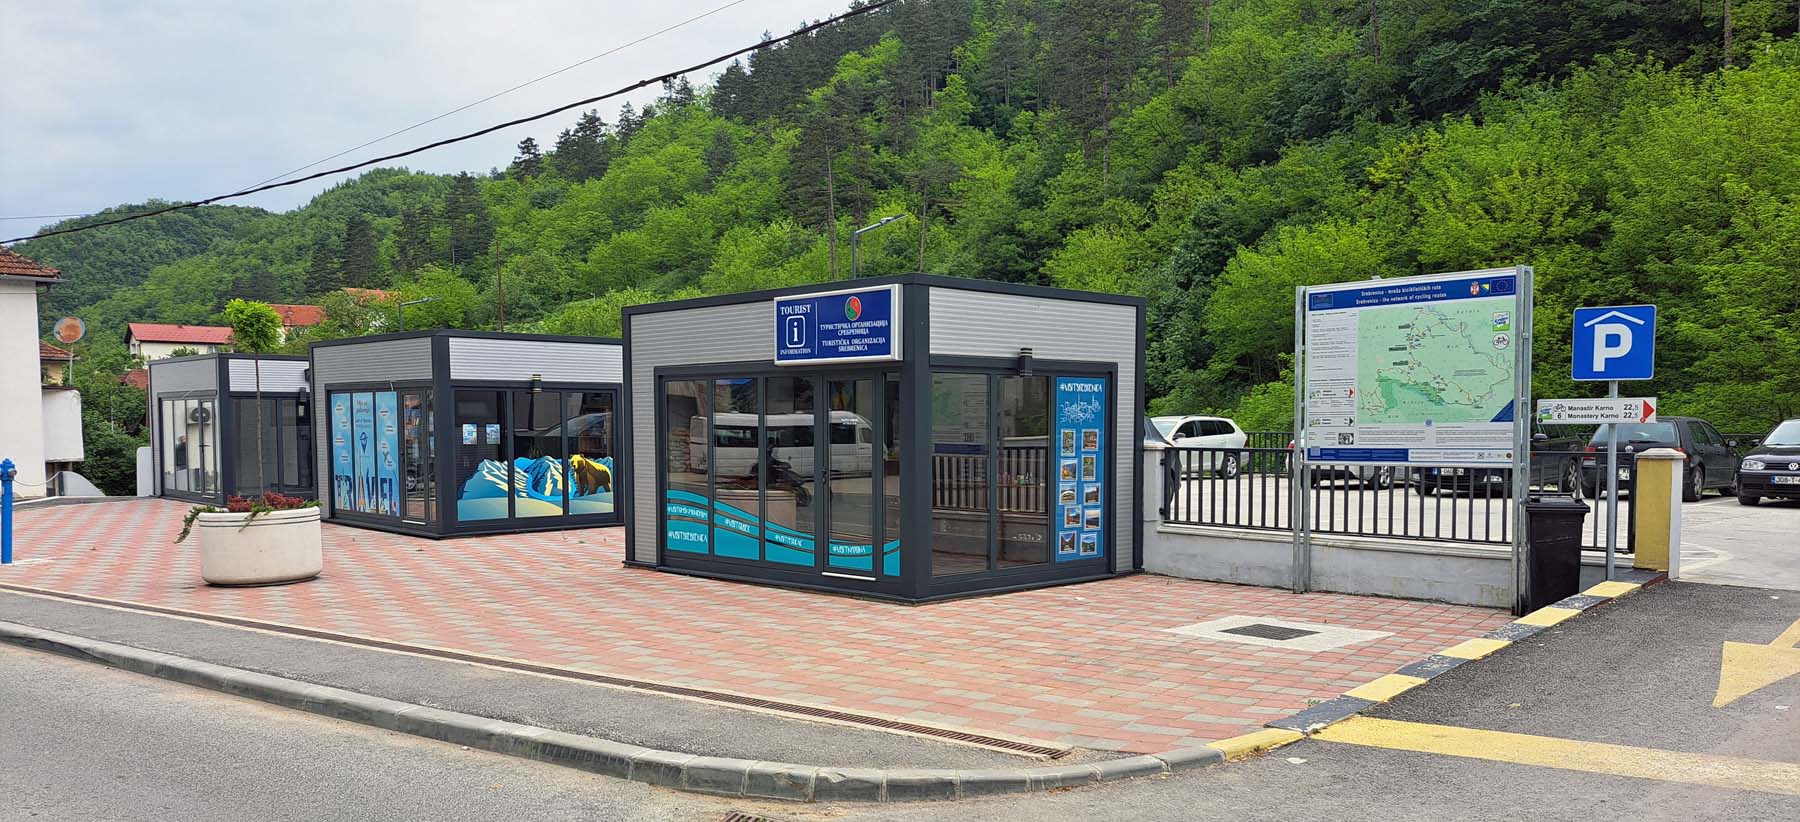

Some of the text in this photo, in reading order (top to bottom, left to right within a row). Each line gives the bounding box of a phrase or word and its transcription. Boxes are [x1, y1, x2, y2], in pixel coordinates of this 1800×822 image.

[1415, 293, 1431, 301] cycling
[780, 304, 811, 315] TOURIST
[820, 323, 851, 331] ТУРИСТИЧКА
[822, 336, 886, 347] TURISTIČKA ORGANIZACIJA
[838, 344, 868, 352] SREBRENICA
[1592, 323, 1633, 372] P
[335, 470, 398, 516] TRAVEL
